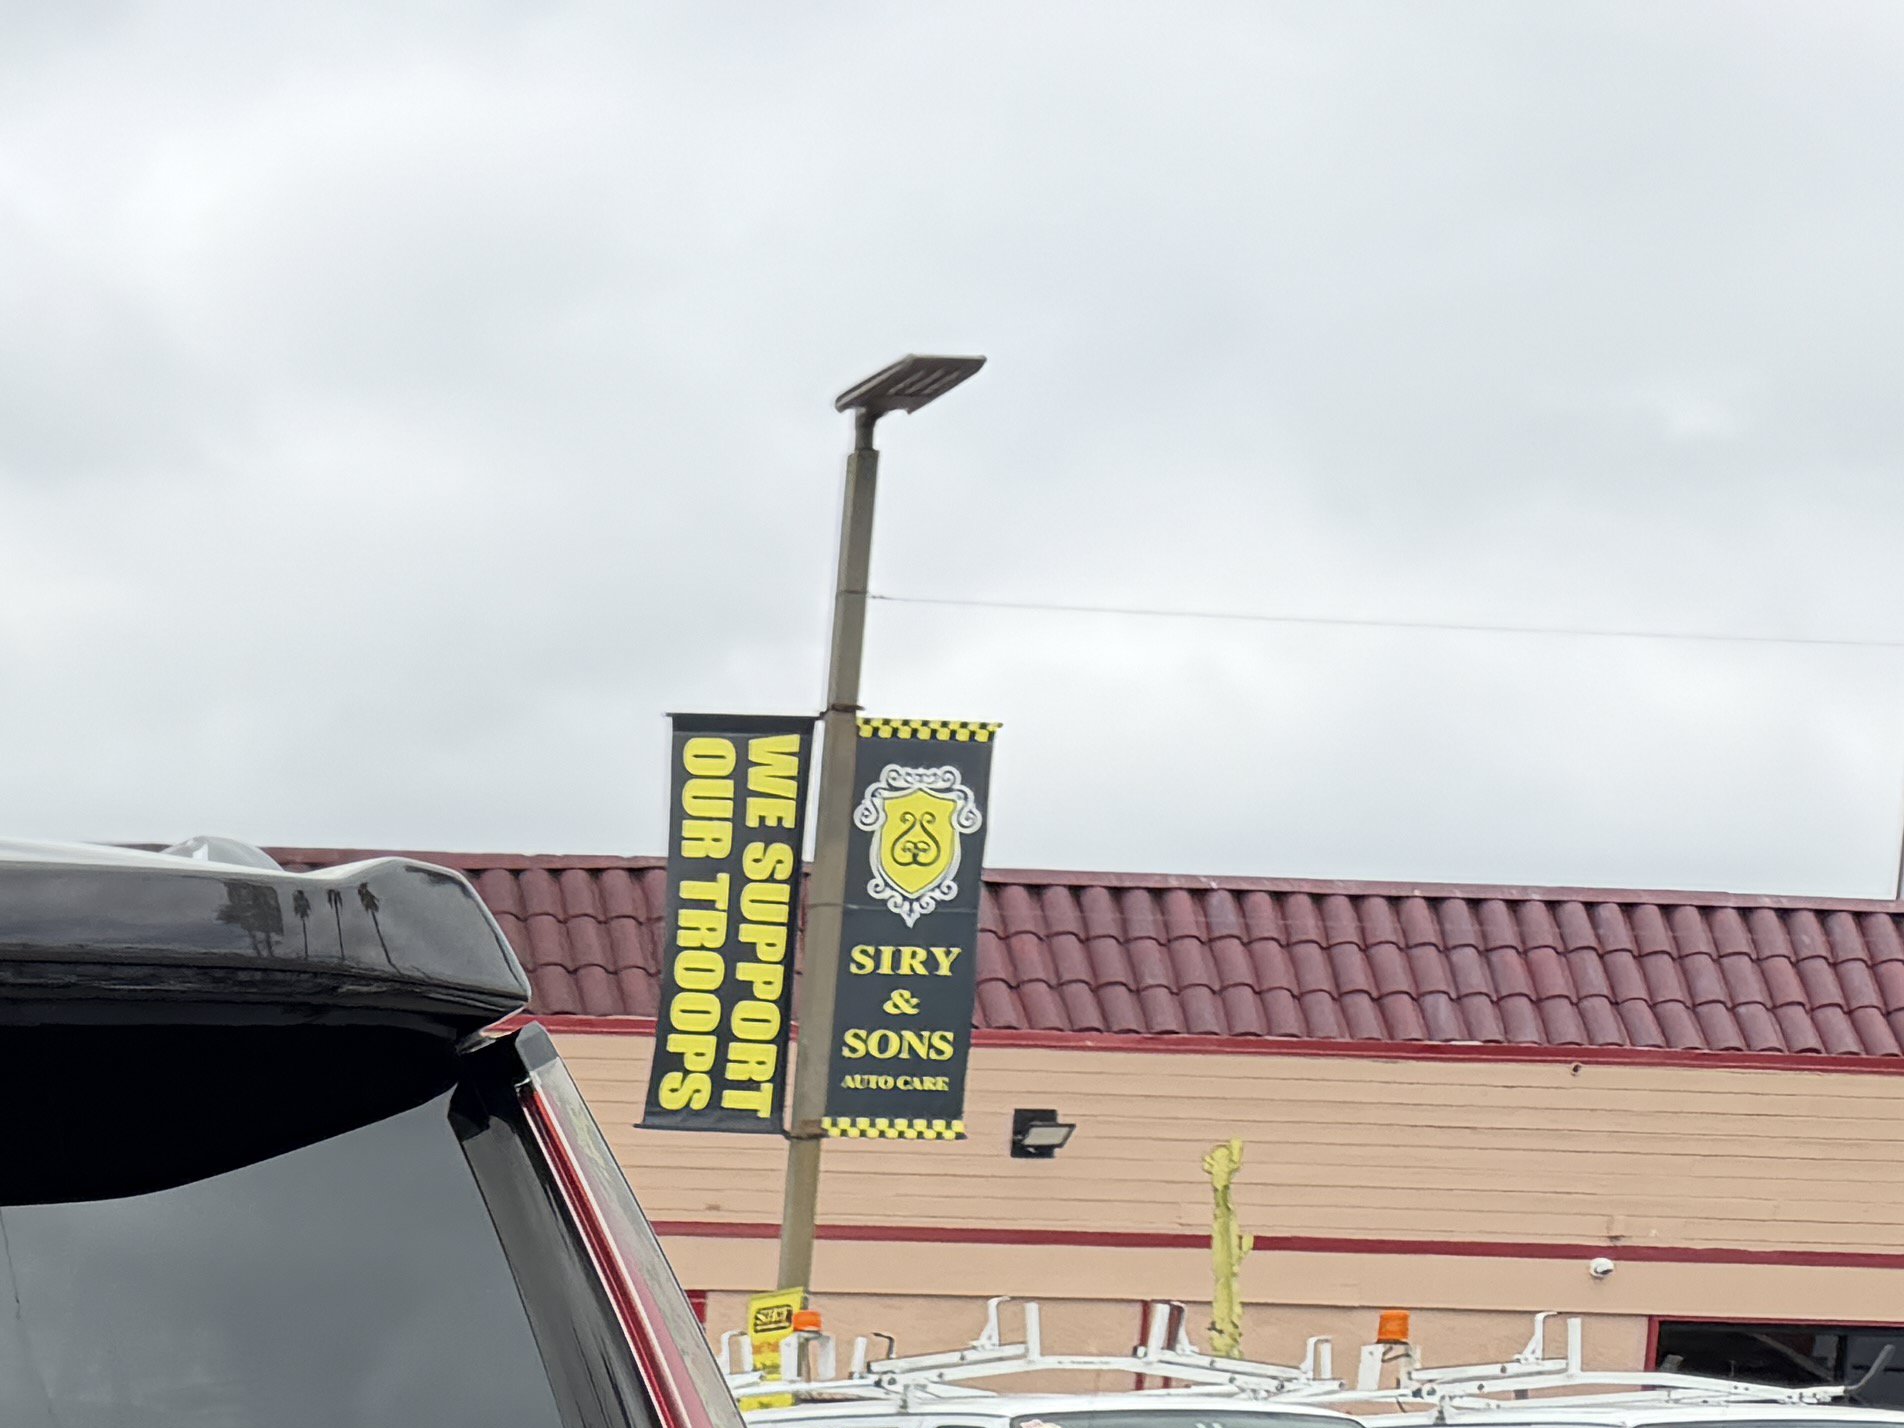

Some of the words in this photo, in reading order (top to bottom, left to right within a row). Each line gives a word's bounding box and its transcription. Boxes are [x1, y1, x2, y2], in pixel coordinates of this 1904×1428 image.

[681, 737, 737, 860] OUR
[745, 734, 801, 829] WE
[658, 872, 730, 1112] TROOPS
[720, 841, 794, 1119] SUPPORT
[849, 945, 962, 977] SIRY
[883, 989, 920, 1016] &
[842, 1029, 955, 1061] SONS
[840, 1074, 895, 1090] AUTO
[896, 1075, 950, 1091] CARE
